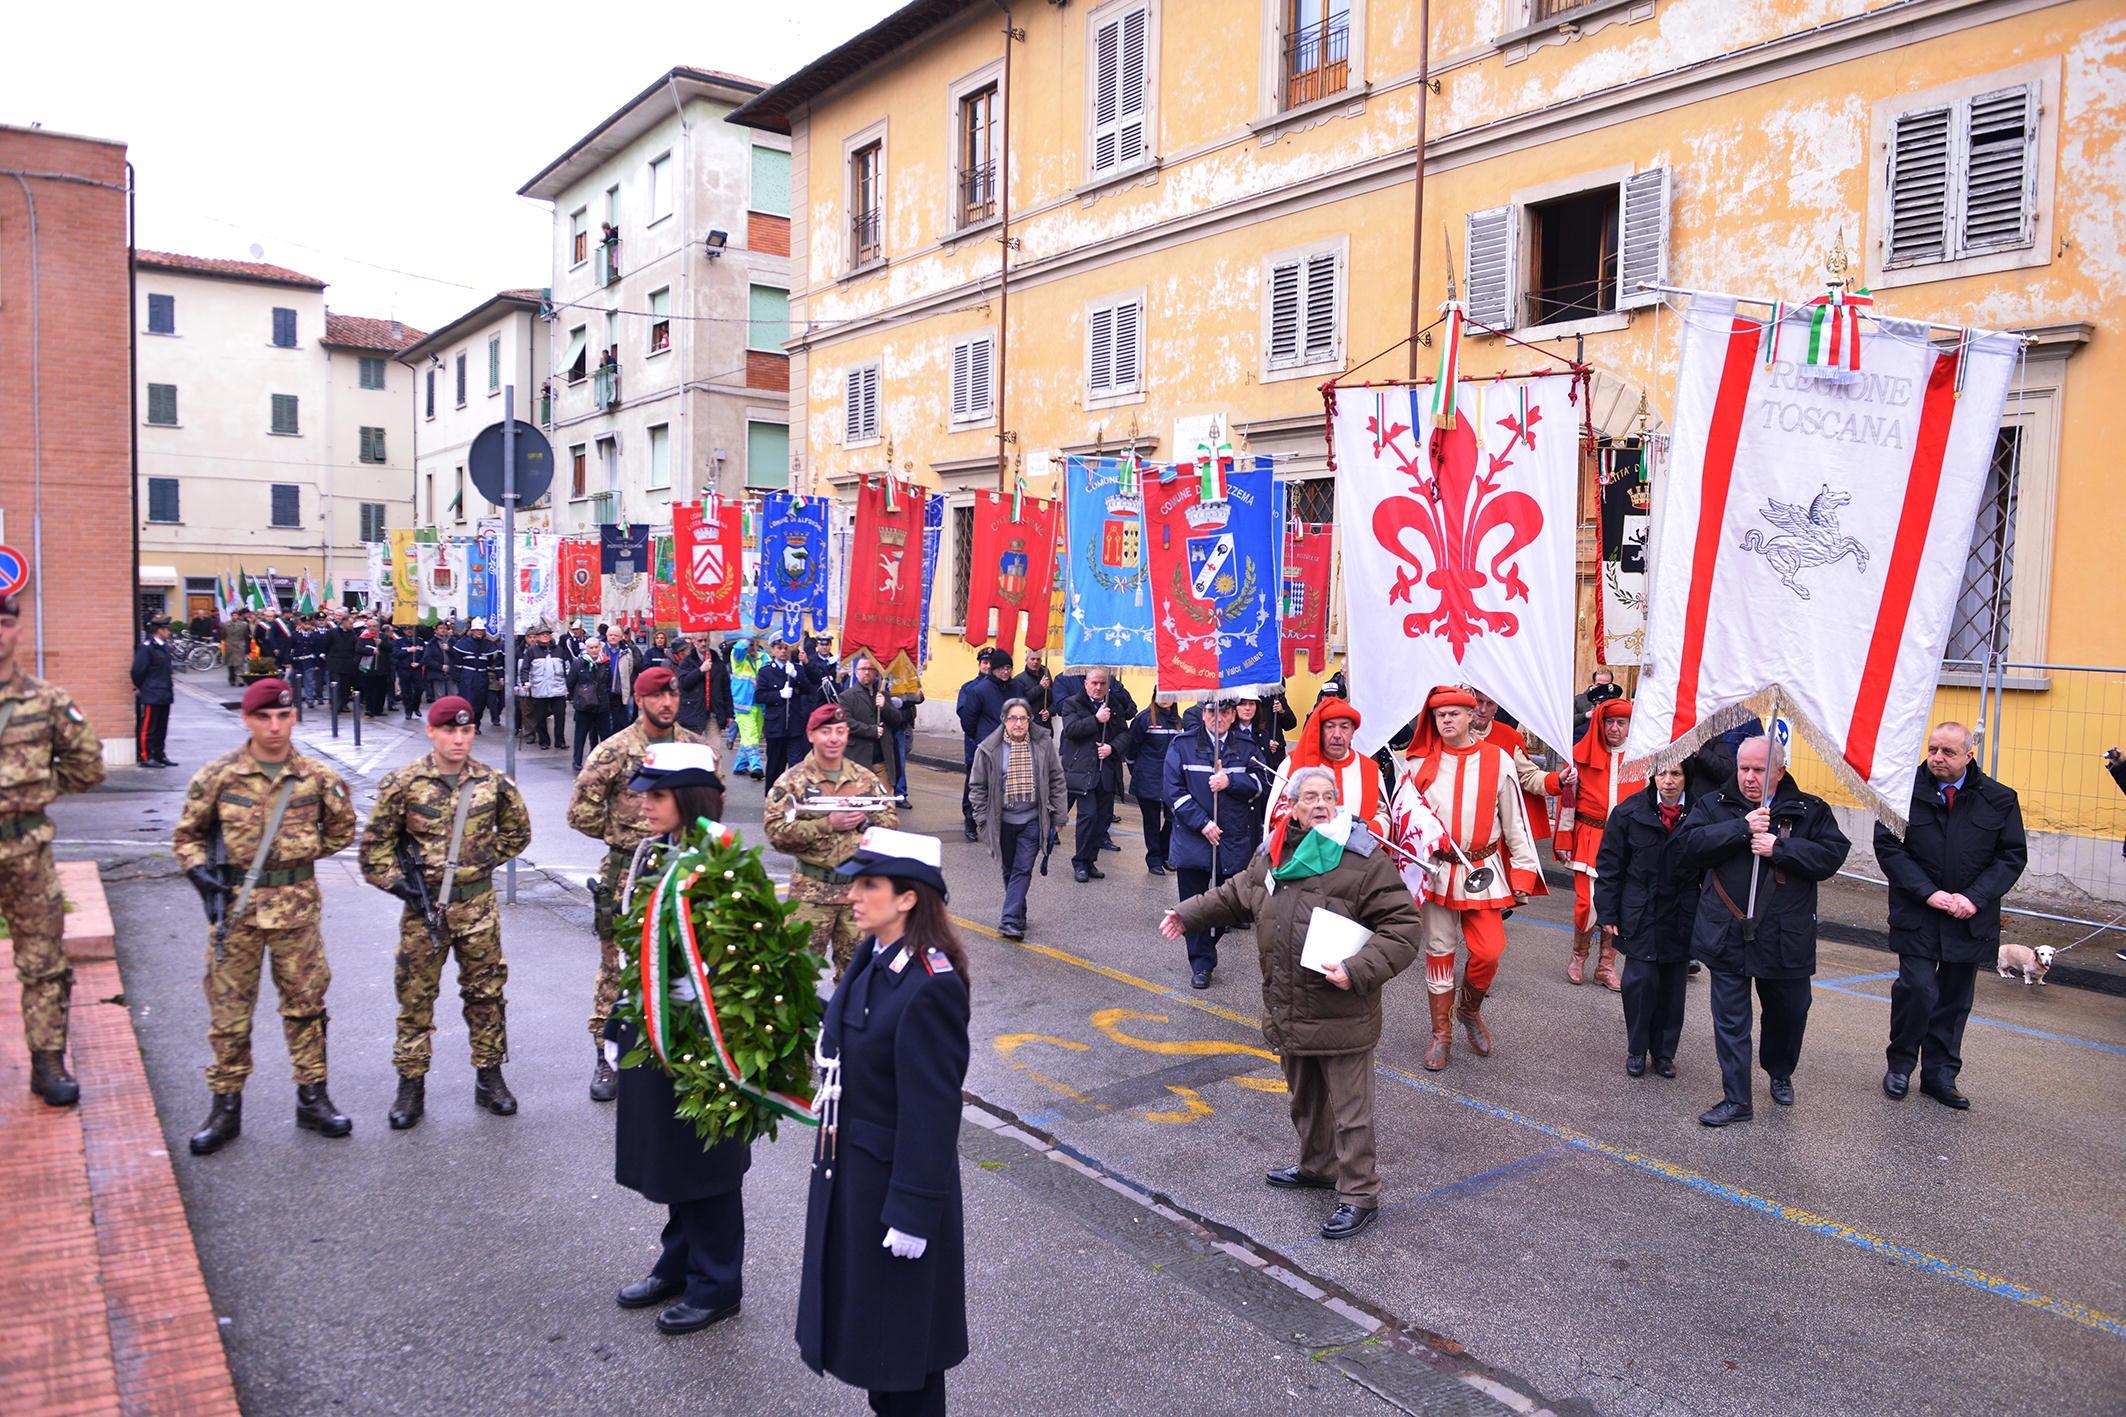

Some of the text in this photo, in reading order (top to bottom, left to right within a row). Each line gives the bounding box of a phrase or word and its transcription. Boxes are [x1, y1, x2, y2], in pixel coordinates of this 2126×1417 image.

[1761, 400, 1904, 449] TOSCANA
[1160, 487, 1193, 515] COMUNE
[1226, 484, 1255, 506] ZZEMA
